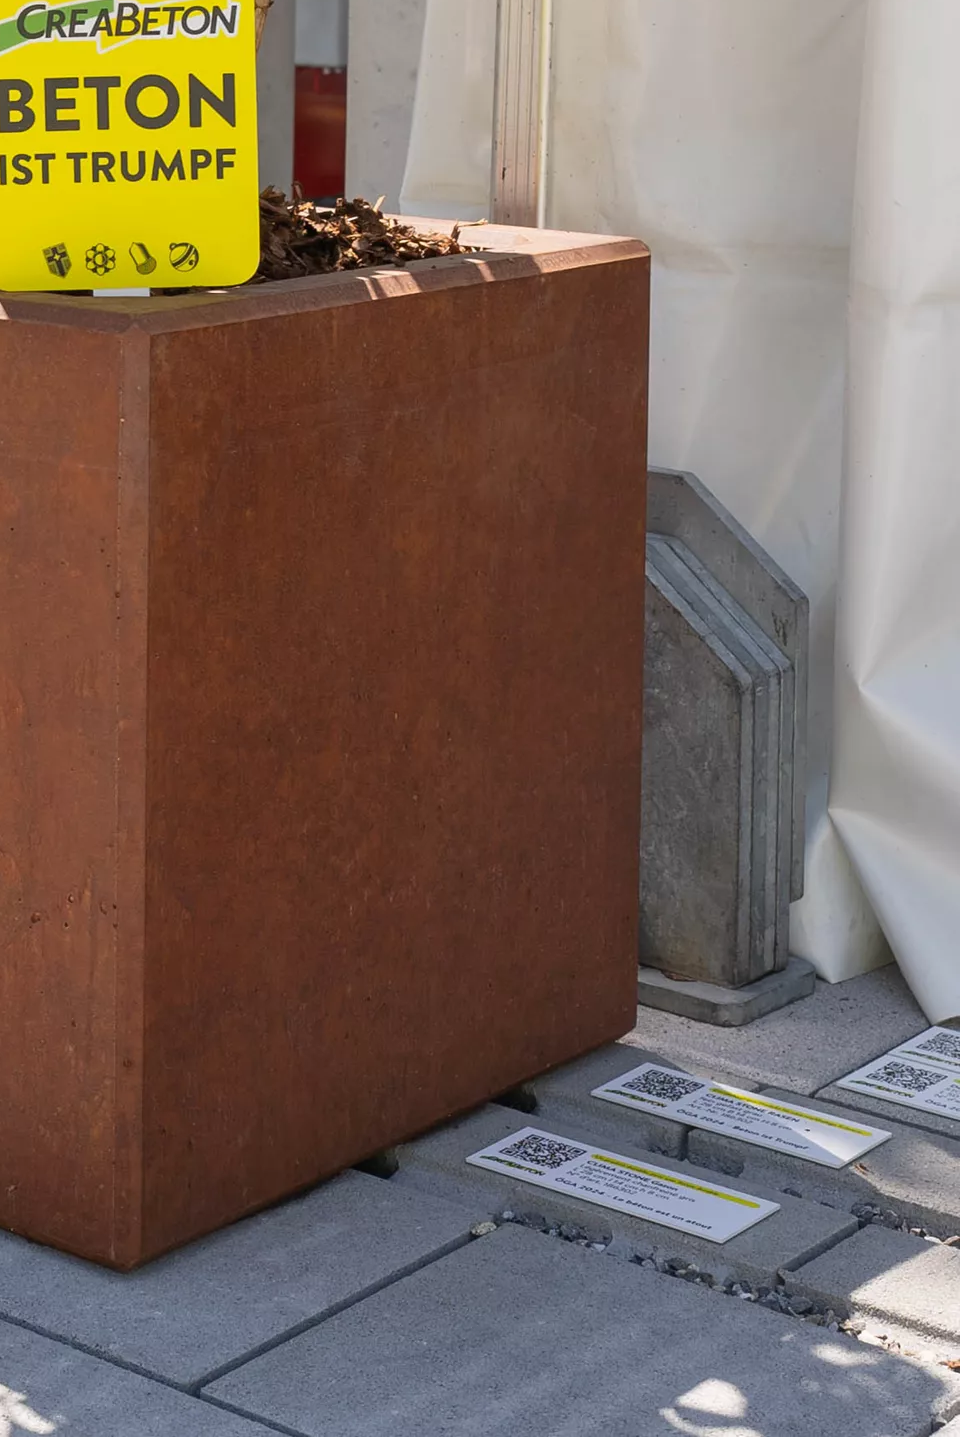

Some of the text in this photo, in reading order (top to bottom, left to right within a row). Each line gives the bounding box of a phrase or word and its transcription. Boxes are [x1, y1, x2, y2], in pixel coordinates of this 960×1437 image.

[17, 2, 240, 40] CREABETON
[0, 148, 237, 185] IST TRUMPF
[772, 1137, 808, 1150] Trumpf
[586, 1160, 617, 1172] CLIMA
[617, 1170, 650, 1182] STONE
[578, 1184, 606, 1195] 2024
[625, 1199, 655, 1211] béton
[654, 1209, 671, 1217] est
[684, 1219, 712, 1230] atout
